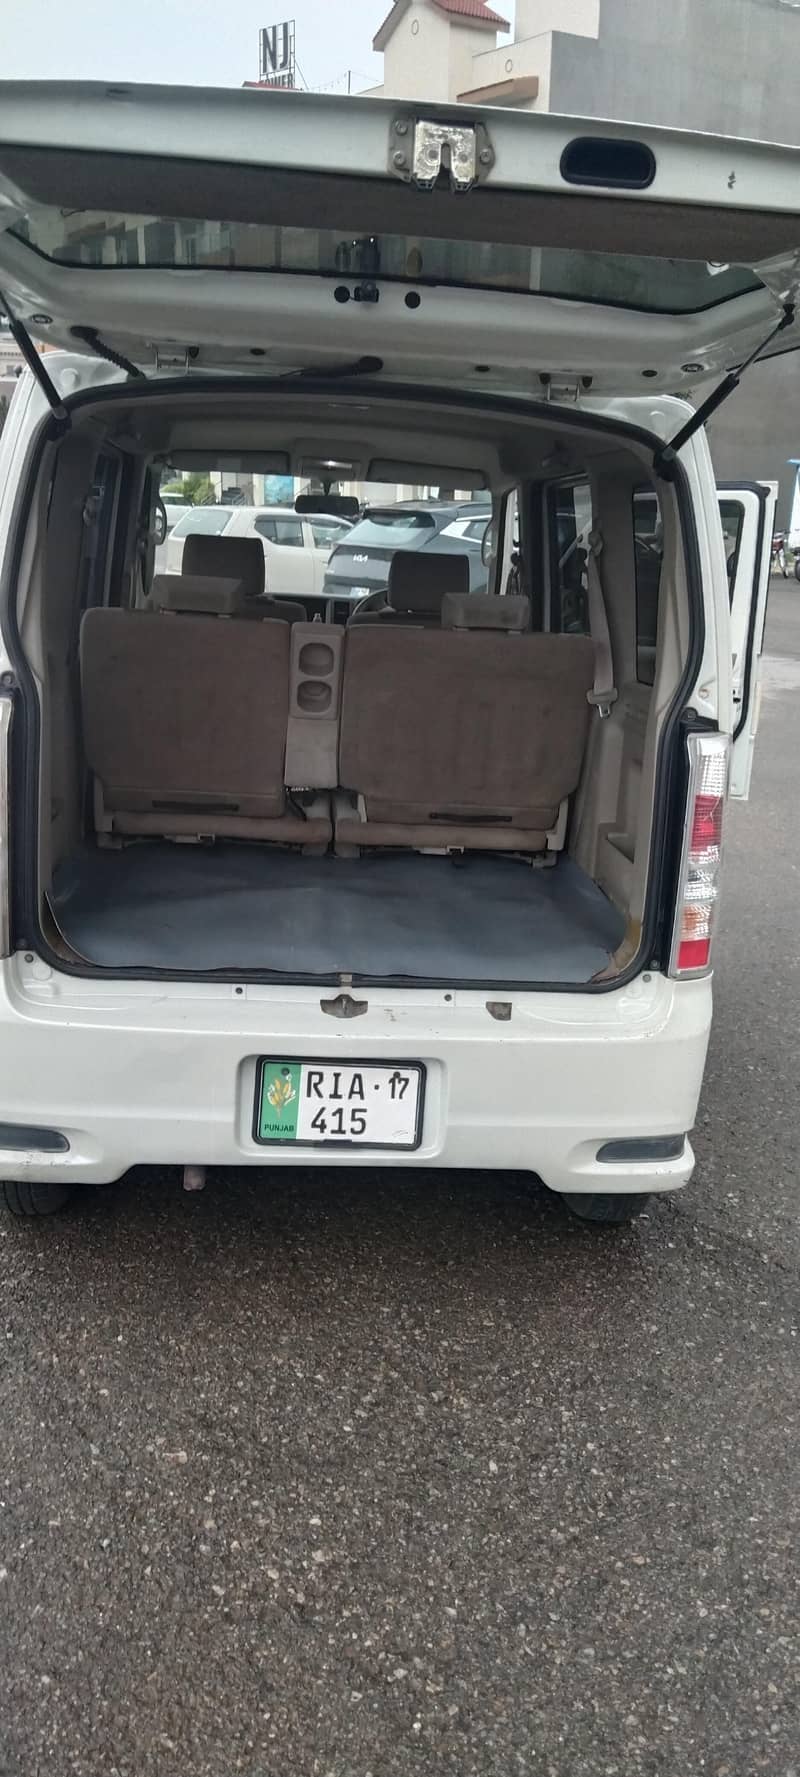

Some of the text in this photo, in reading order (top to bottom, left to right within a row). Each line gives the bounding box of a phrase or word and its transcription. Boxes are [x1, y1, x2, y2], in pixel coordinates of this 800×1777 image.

[262, 22, 289, 74] NJ
[260, 73, 295, 88] WER
[306, 1071, 365, 1100] RIA
[388, 1077, 410, 1100] 17
[264, 1123, 295, 1132] PUNJAB
[310, 1107, 368, 1135] 415
